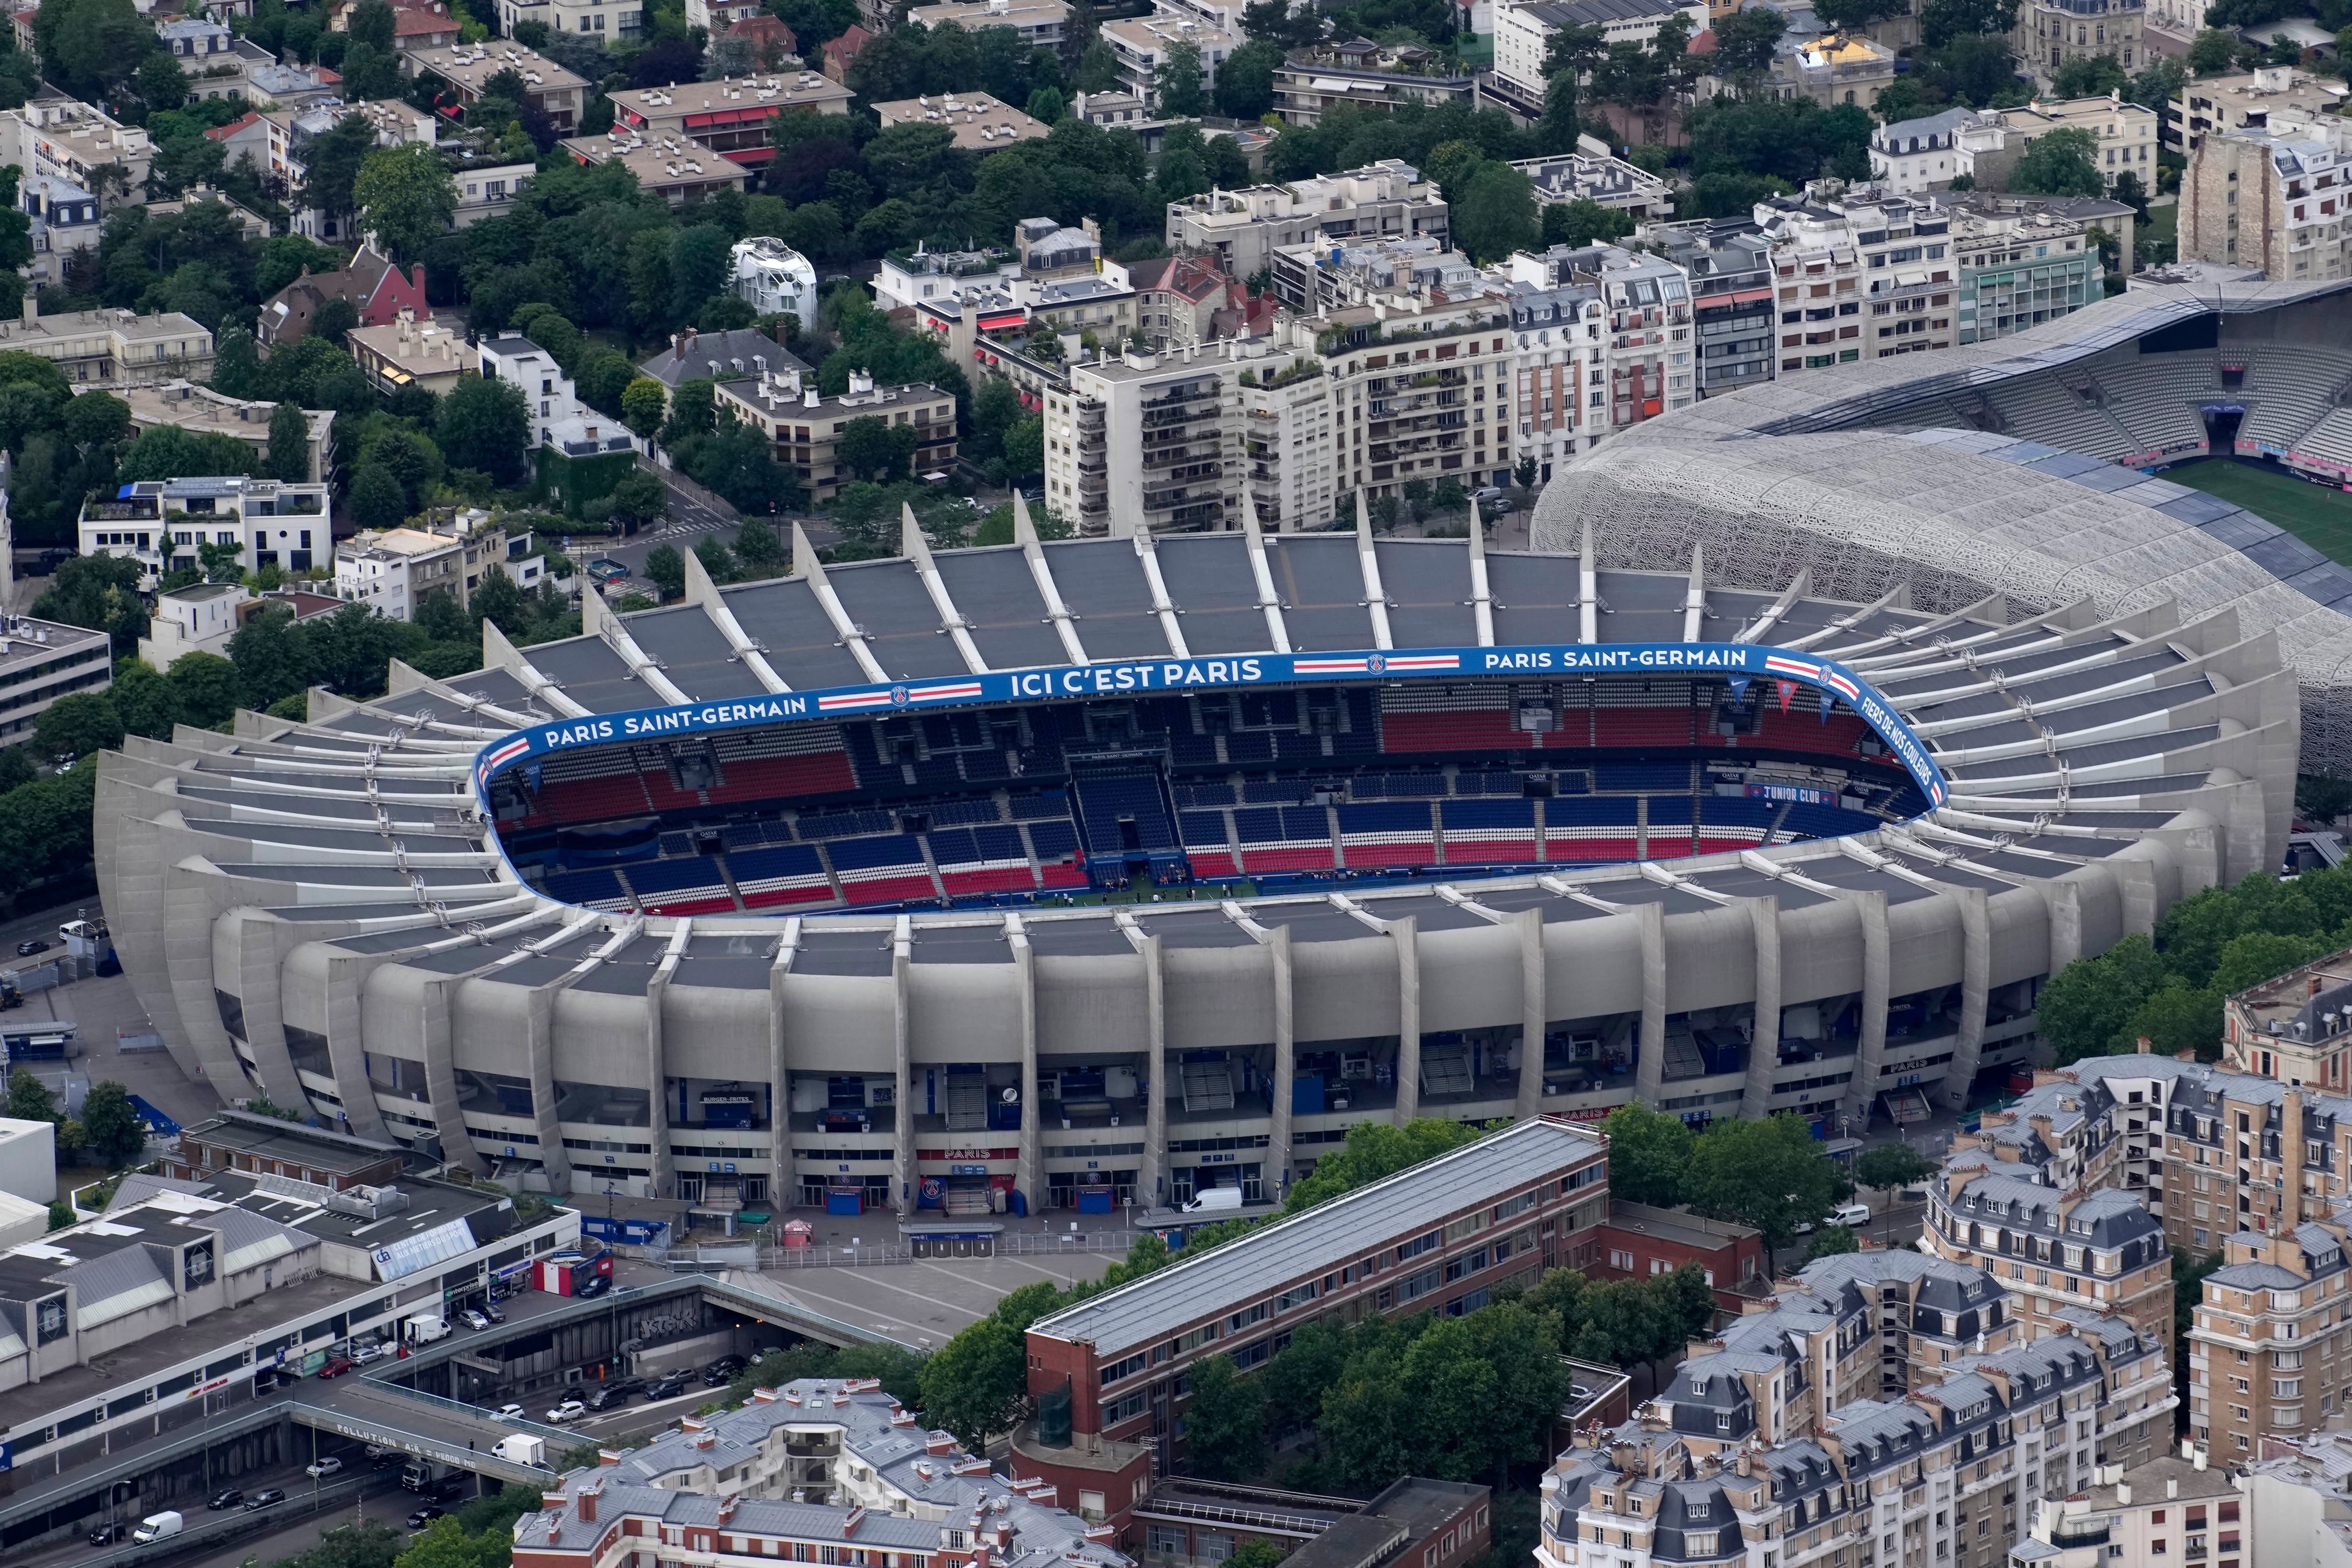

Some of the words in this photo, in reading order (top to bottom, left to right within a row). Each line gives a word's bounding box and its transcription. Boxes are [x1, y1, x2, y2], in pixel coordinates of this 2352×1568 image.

[1486, 653, 1552, 668] PARIS
[1564, 650, 1746, 666] SAINT-GERMAIN
[1011, 673, 1052, 696] ICI
[1063, 666, 1154, 692] C'EST
[1164, 659, 1261, 685] PARIS
[545, 721, 613, 747] PARIS
[625, 697, 806, 734] SAINT-GERMAIN
[1861, 696, 1885, 725] FIERS
[1881, 715, 1894, 735] DE
[1890, 725, 1906, 750] NOS
[1903, 741, 1932, 786] COULEURS
[1764, 786, 1797, 801] JUNIOR
[1800, 789, 1820, 803] CLUB
[1890, 1058, 1928, 1073] PARIS
[1560, 1108, 1604, 1120] PARIS
[944, 1148, 991, 1159] PARIS
[394, 1236, 417, 1251] CENTRE
[416, 1234, 426, 1242] DE
[426, 1220, 462, 1238] FORMATION
[397, 1249, 411, 1259] AUX
[436, 1235, 445, 1244] DU
[446, 1227, 466, 1240] SPORT
